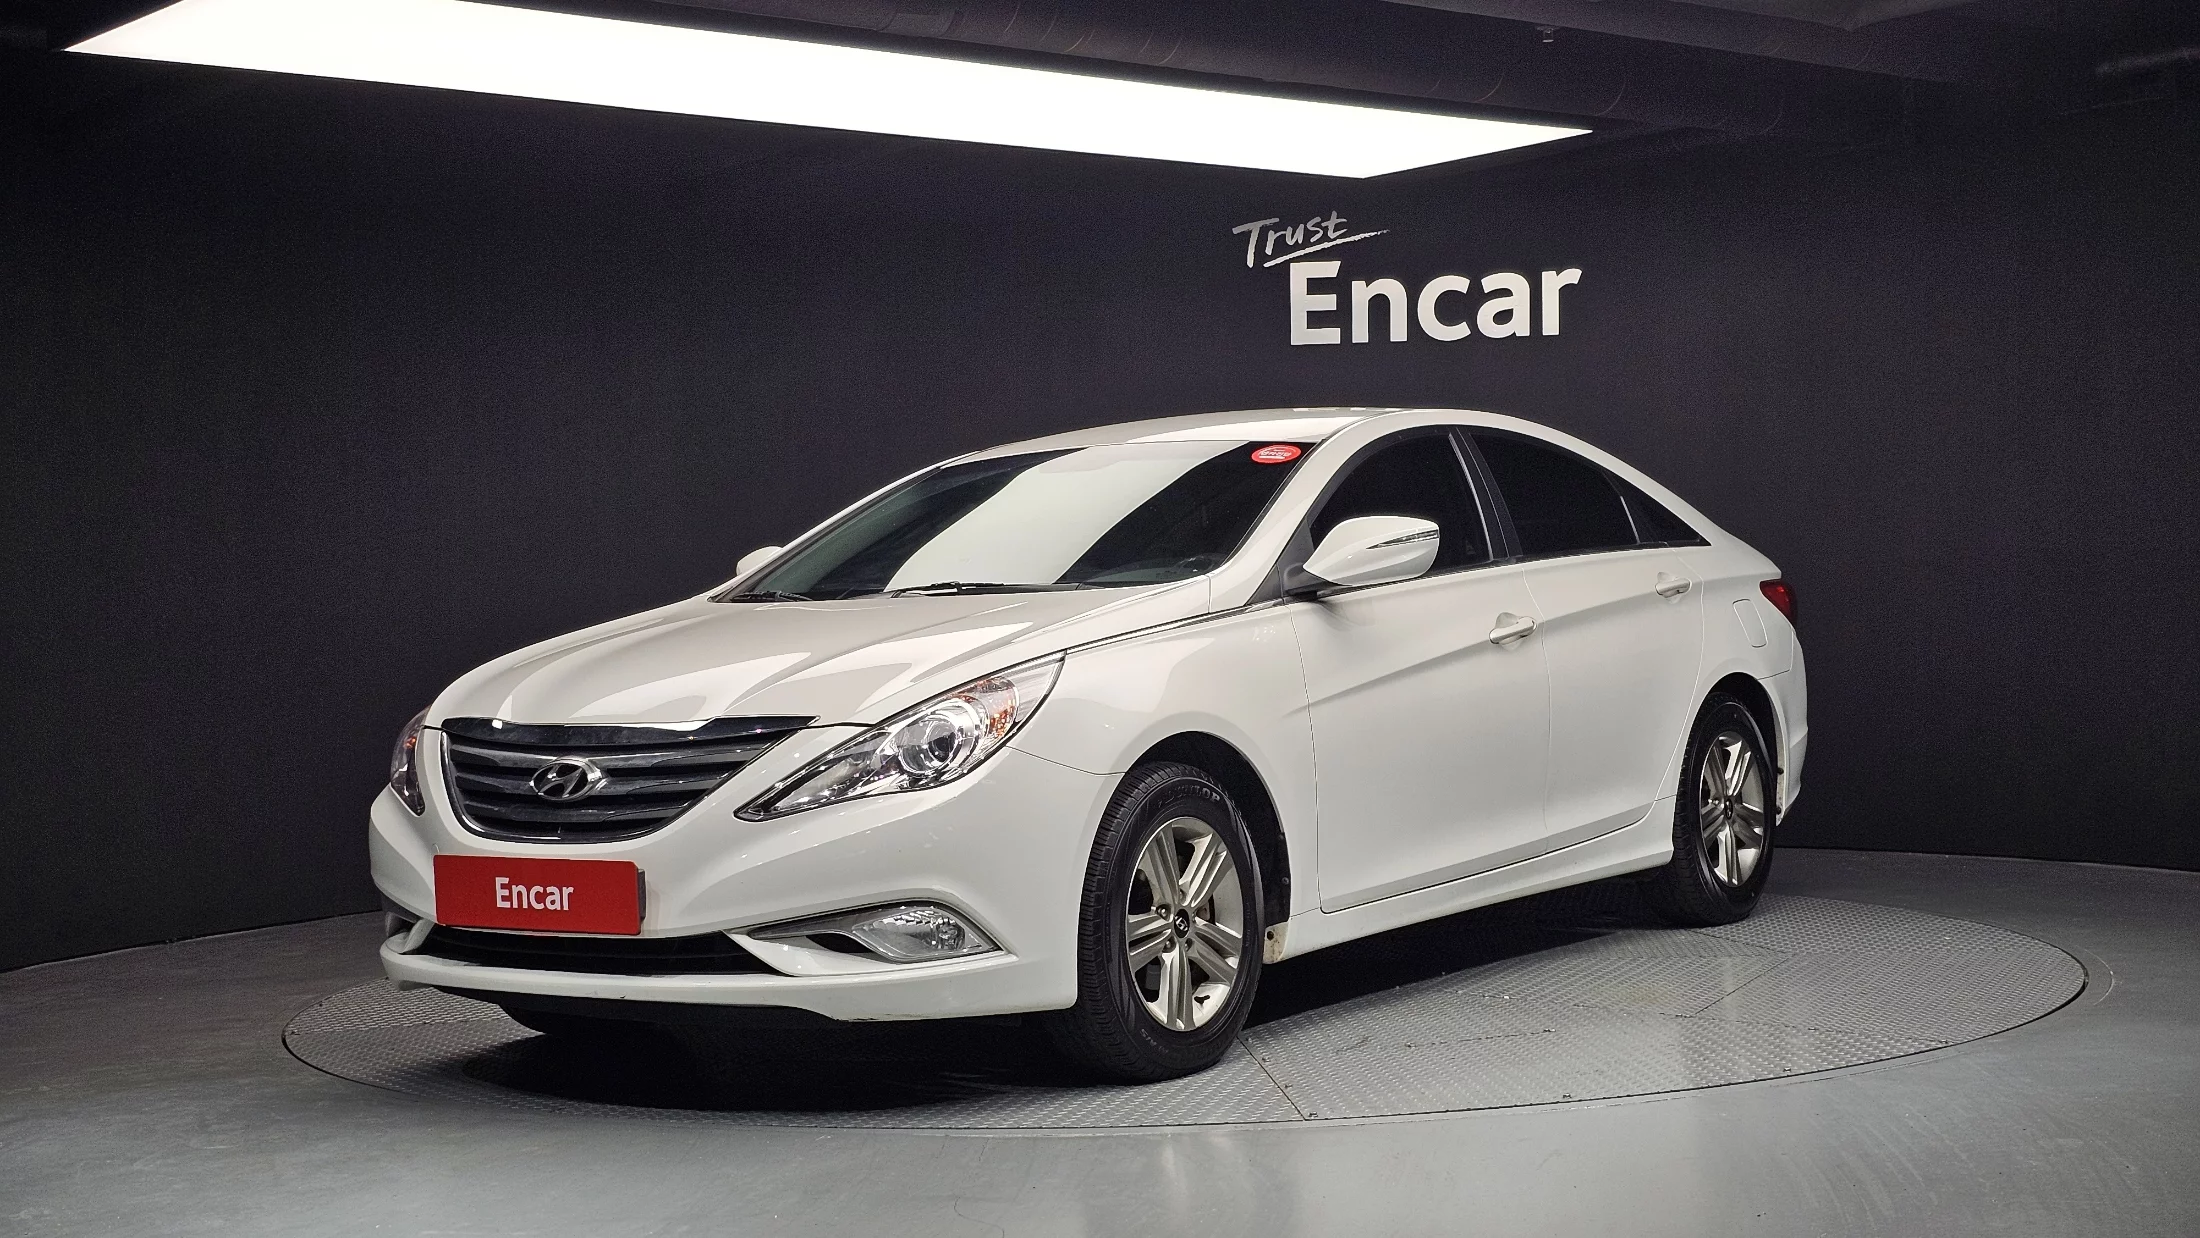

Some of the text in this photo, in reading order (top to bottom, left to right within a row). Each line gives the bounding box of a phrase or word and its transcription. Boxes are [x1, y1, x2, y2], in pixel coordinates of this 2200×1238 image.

[1232, 210, 1348, 268] Trust
[1290, 260, 1583, 346] Encar
[495, 876, 575, 911] Encar
